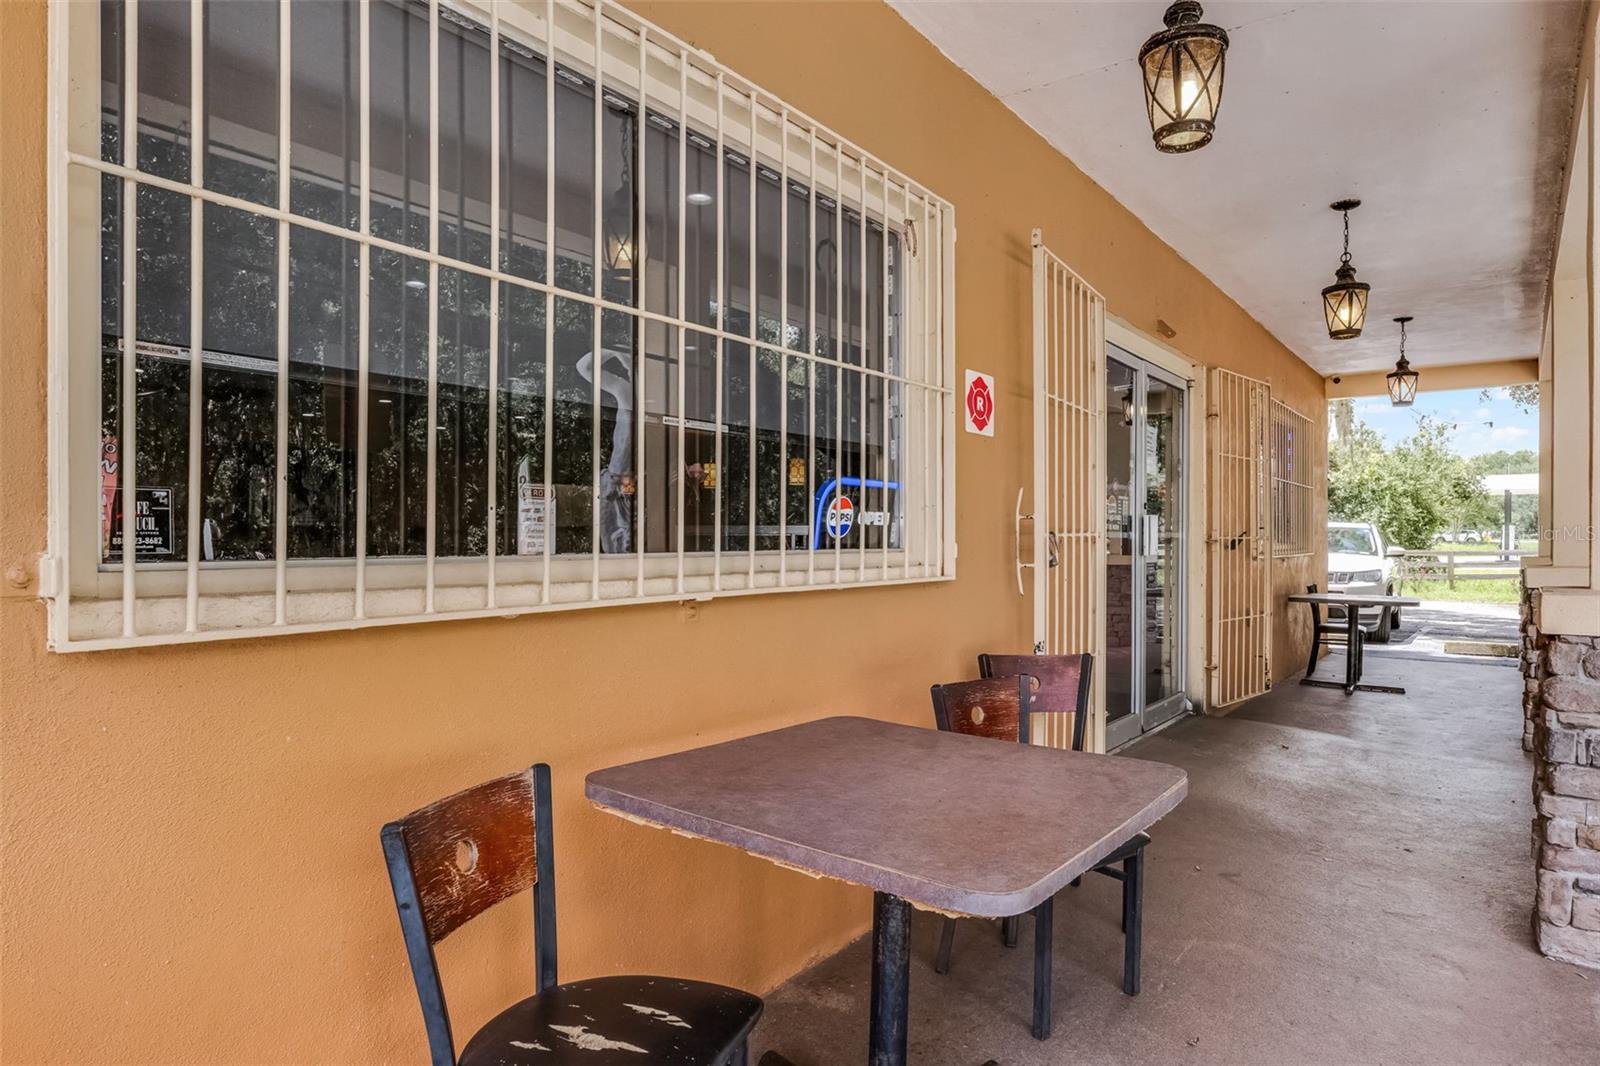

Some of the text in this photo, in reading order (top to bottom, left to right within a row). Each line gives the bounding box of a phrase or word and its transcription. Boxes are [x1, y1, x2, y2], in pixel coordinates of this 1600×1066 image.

[977, 396, 984, 411] R
[831, 513, 852, 522] PPSI
[112, 537, 163, 545] 8823-8682
